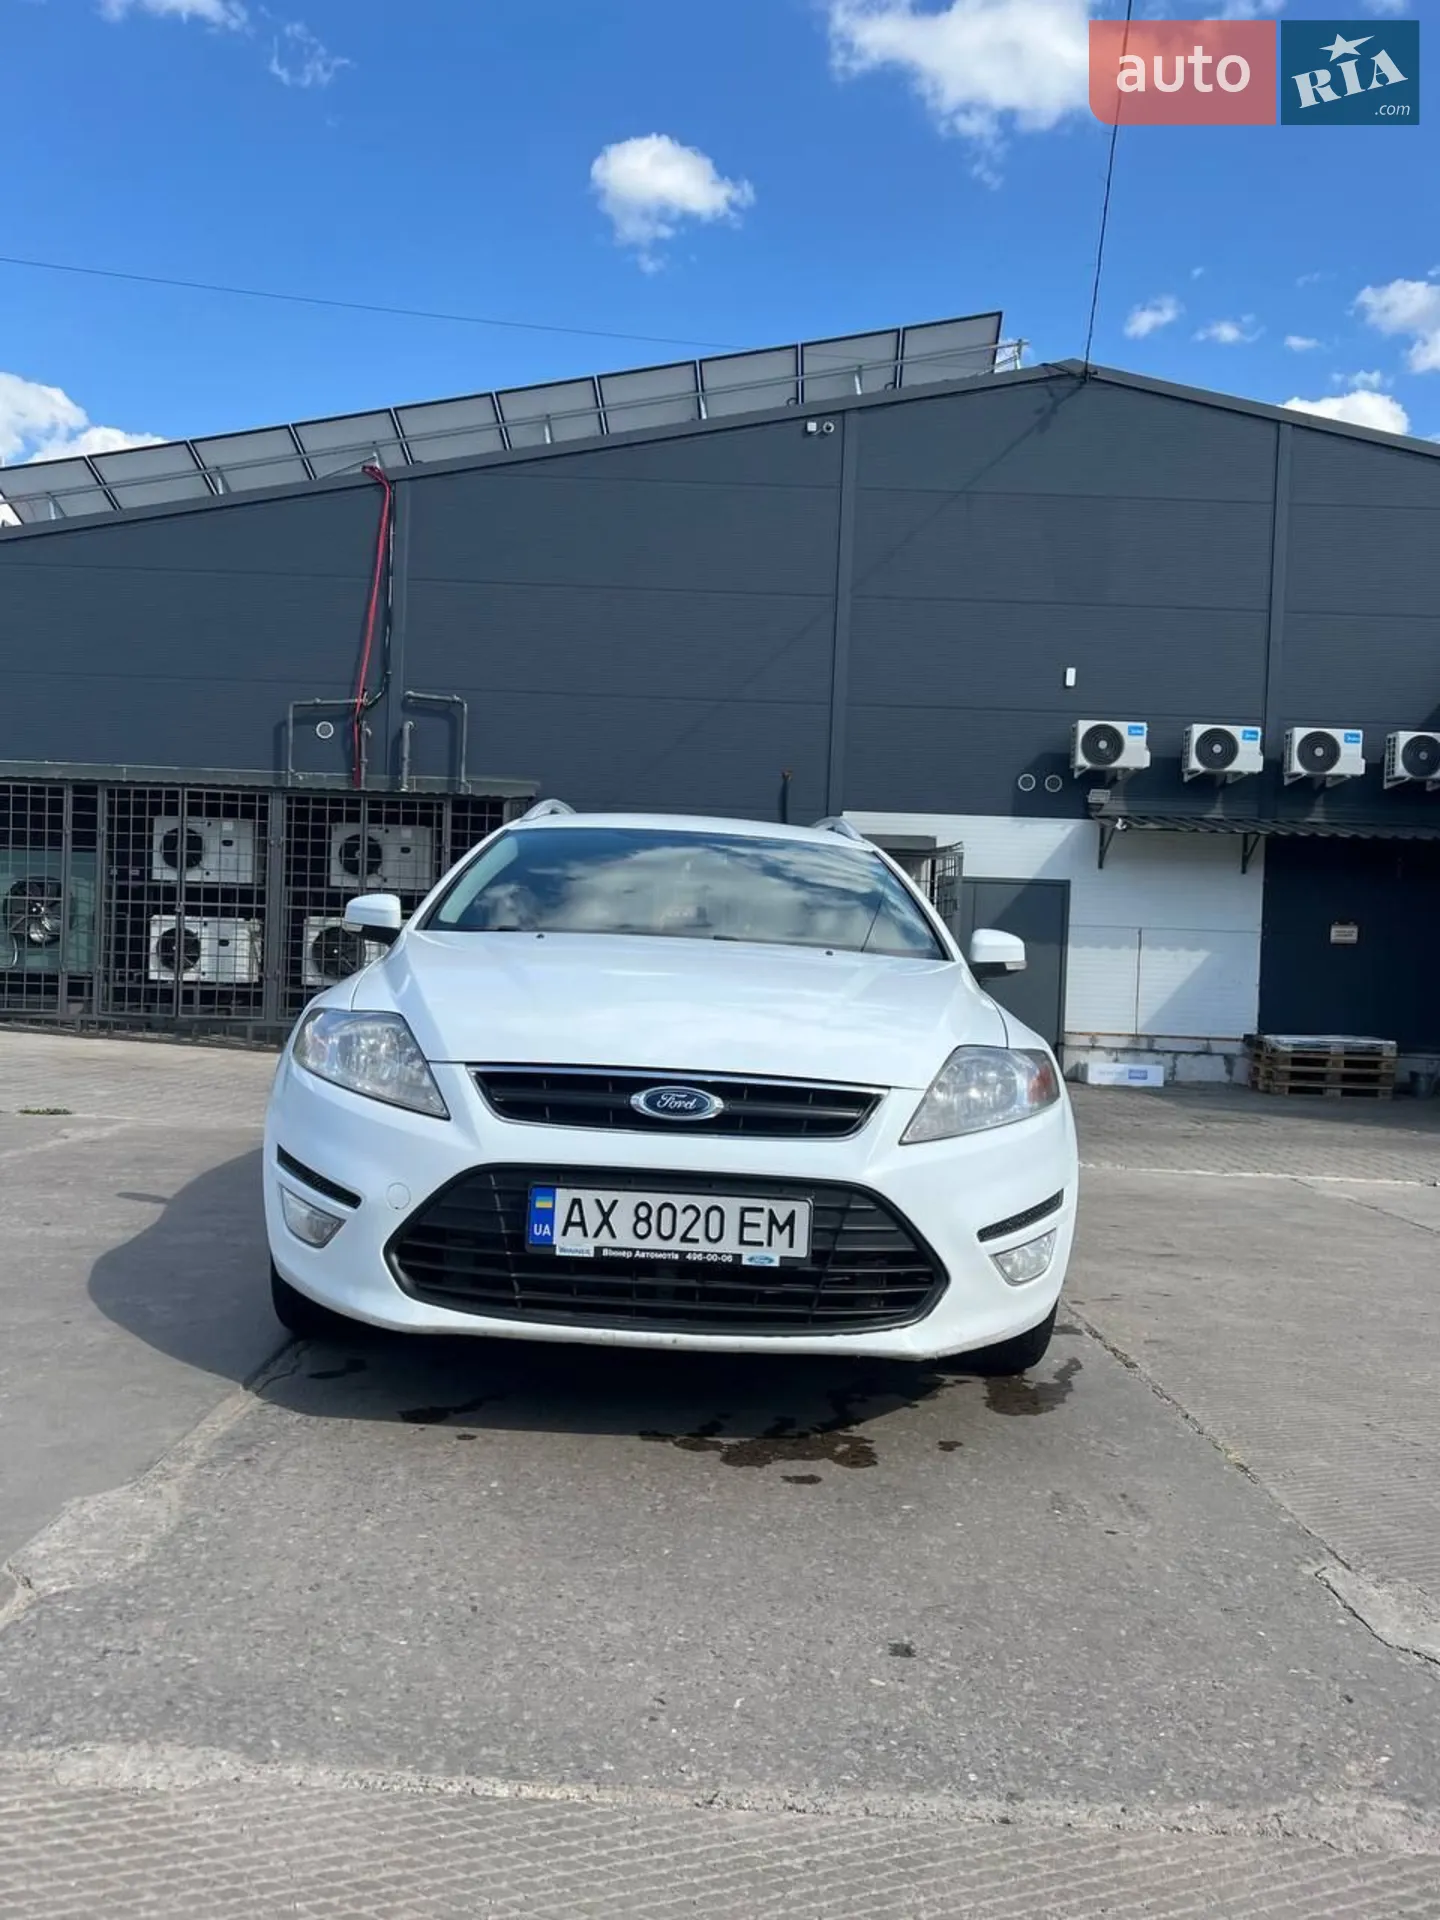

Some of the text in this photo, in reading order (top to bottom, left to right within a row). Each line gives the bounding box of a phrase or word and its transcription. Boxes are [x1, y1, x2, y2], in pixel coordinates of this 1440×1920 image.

[656, 1093, 697, 1110] Ford
[533, 1223, 552, 1237] UA
[561, 1197, 796, 1249] AX 8020 EM
